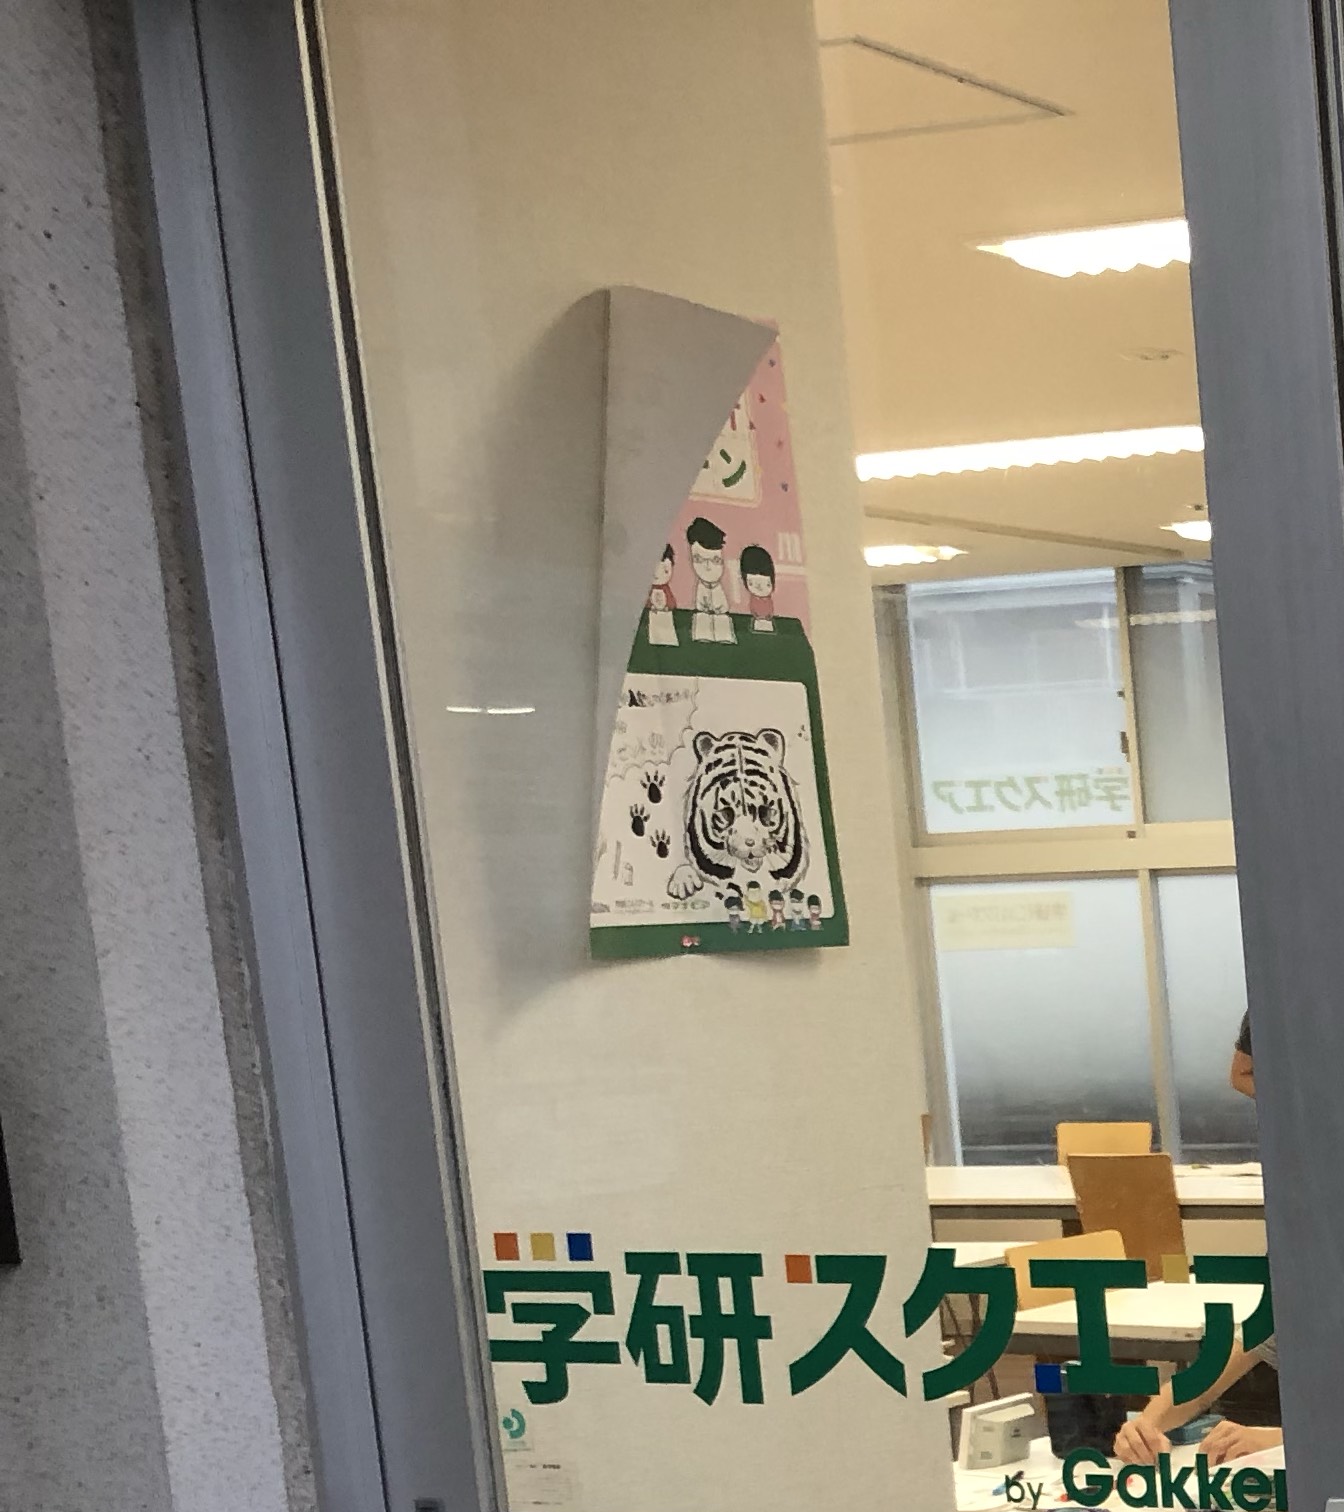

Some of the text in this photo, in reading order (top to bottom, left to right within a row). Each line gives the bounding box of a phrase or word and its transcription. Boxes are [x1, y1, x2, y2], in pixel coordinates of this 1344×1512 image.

[484, 1232, 1274, 1406] 学研スクエア
[1005, 1473, 1044, 1510] by
